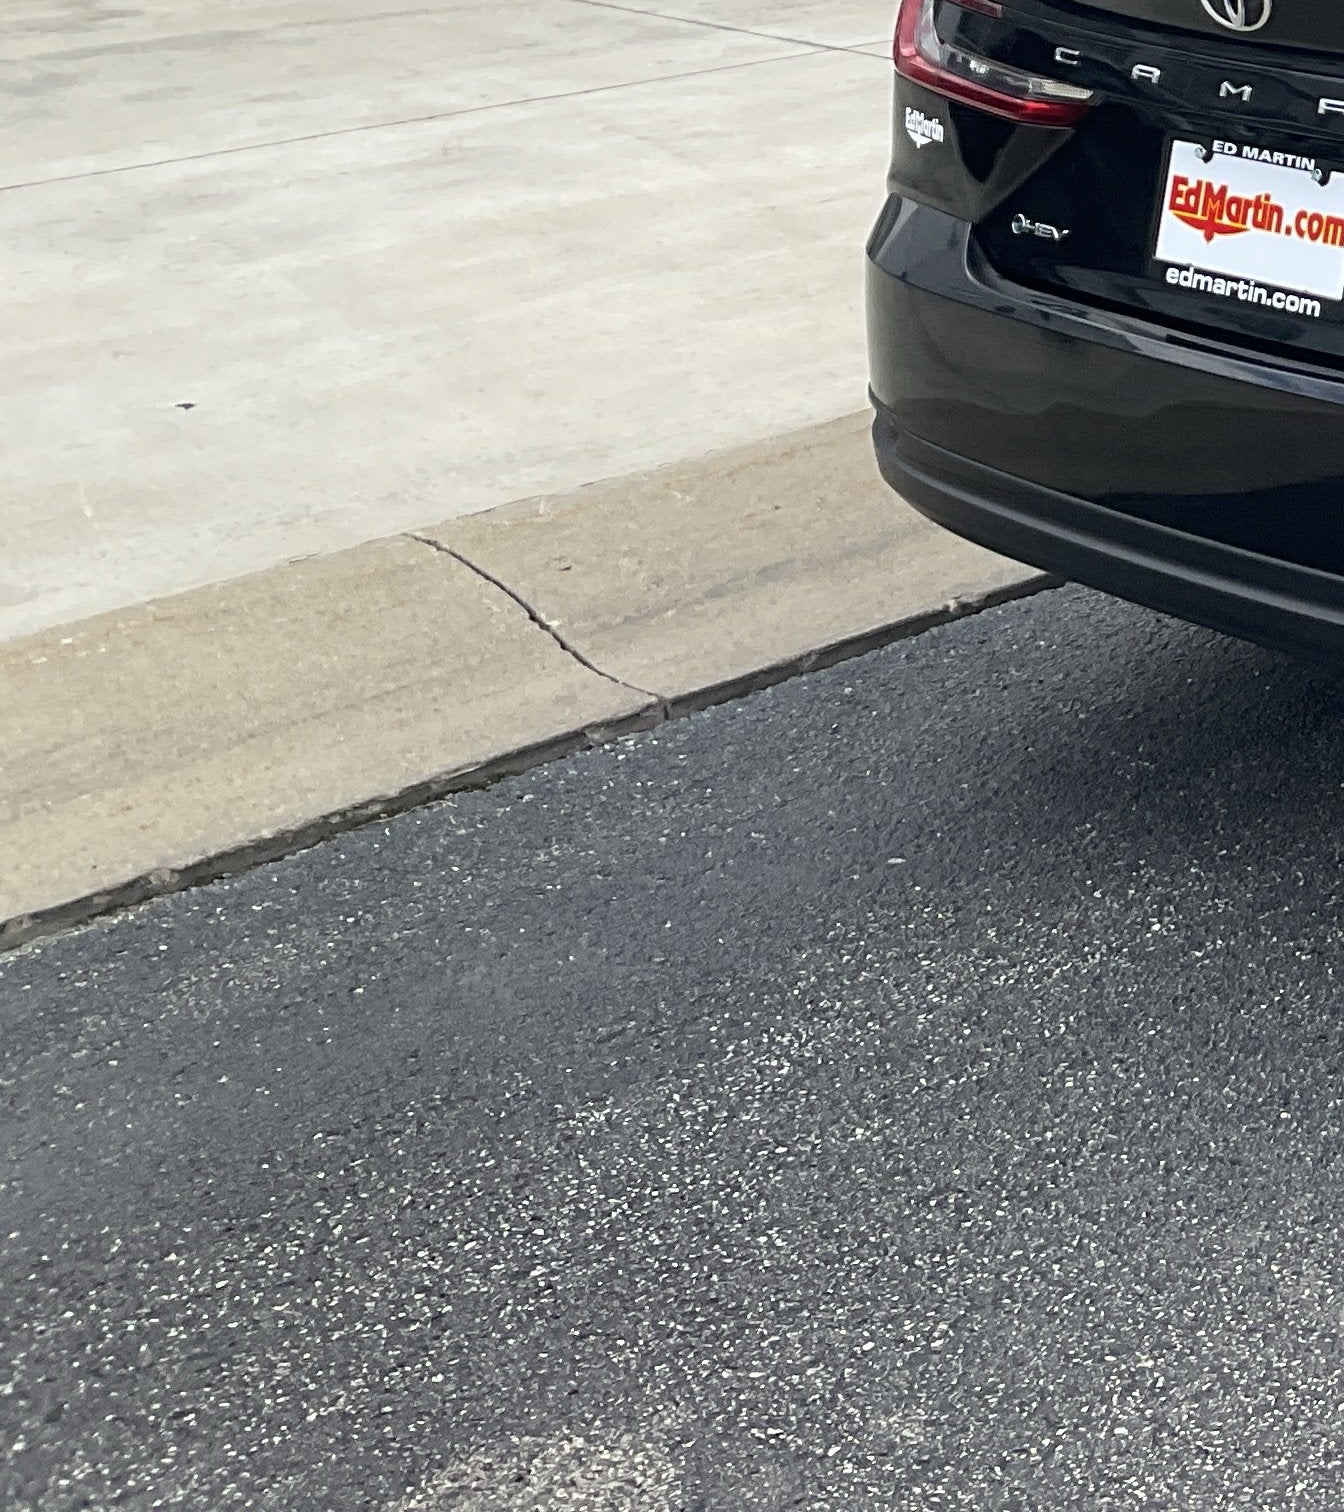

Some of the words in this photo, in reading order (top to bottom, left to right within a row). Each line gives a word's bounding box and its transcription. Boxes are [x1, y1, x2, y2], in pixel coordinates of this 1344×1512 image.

[1212, 140, 1238, 155] ED
[1242, 146, 1316, 170] MARTIN
[1165, 266, 1321, 317] edmartin.com
